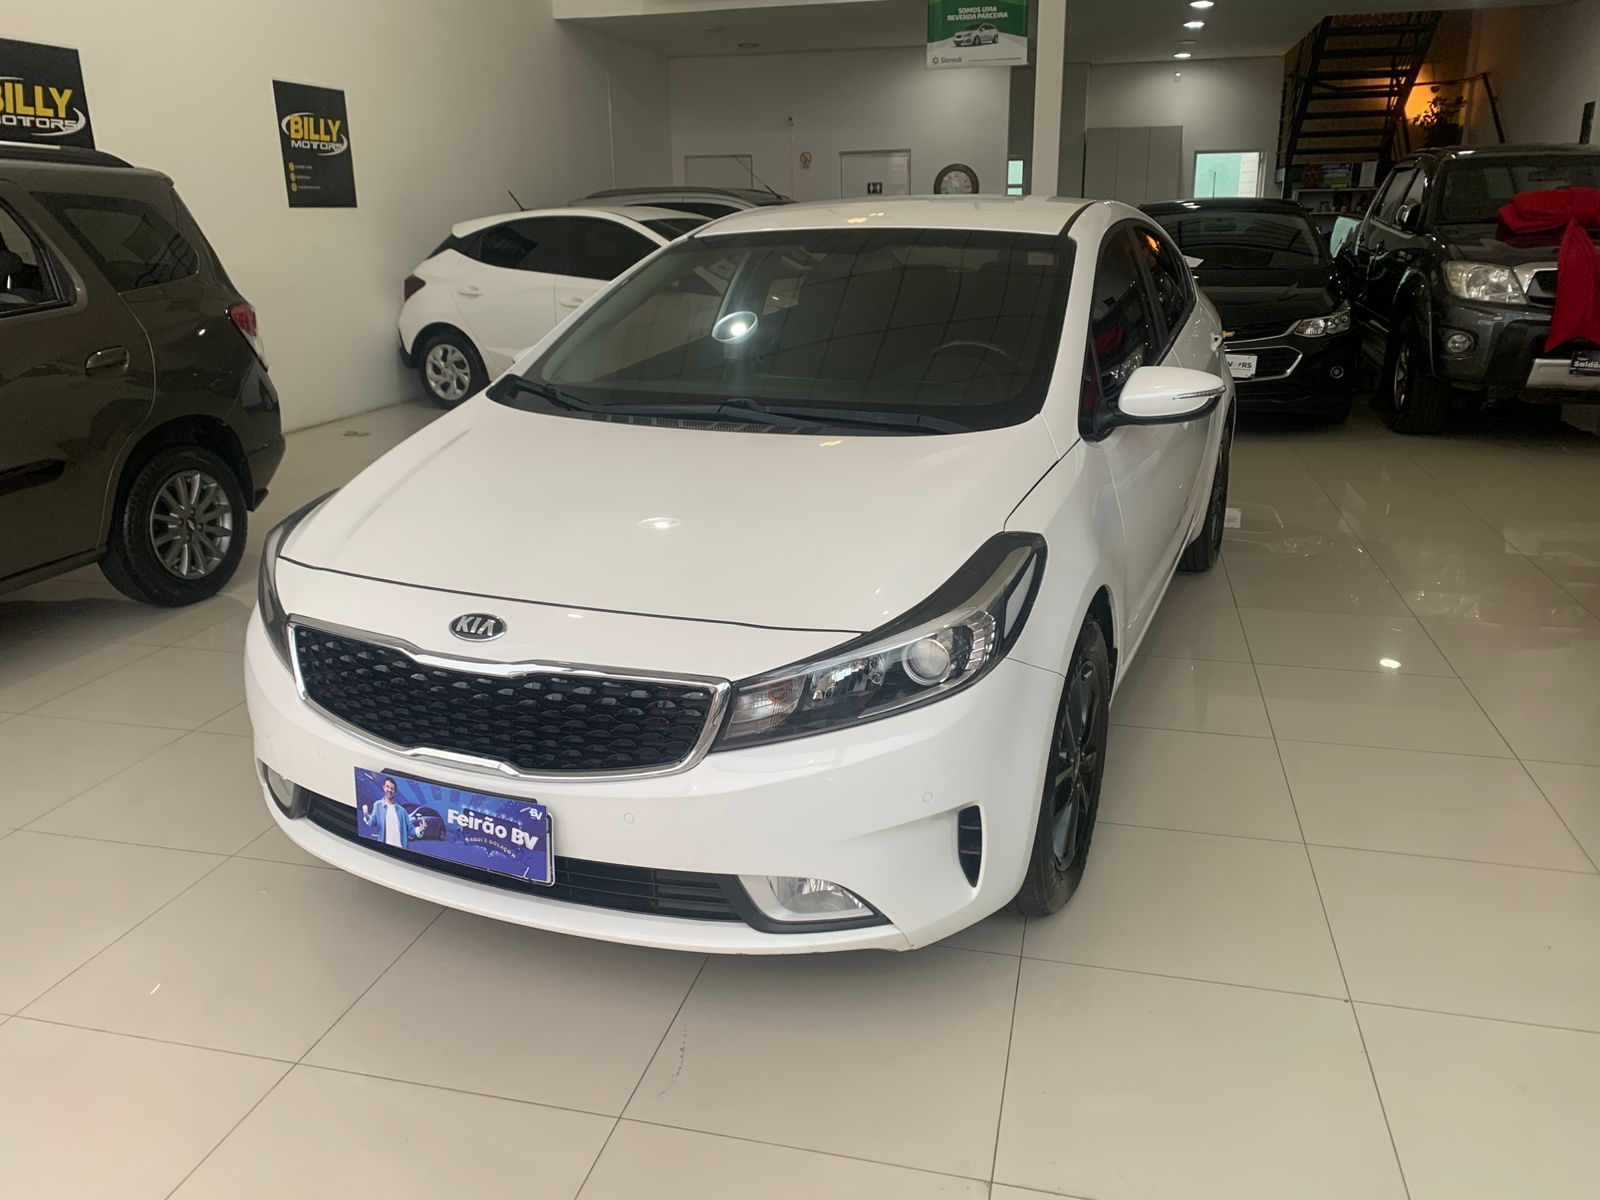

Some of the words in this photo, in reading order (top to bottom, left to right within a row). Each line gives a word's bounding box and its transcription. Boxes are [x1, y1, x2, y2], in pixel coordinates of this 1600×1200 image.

[947, 12, 977, 21] REVENDA
[977, 11, 1008, 19] PARCEIRA
[0, 82, 73, 118] ILLY
[0, 115, 77, 131] OTORS
[290, 115, 341, 142] BILLY
[291, 140, 343, 152] MOTORS
[455, 615, 496, 636] KIA
[529, 807, 543, 820] BV
[447, 808, 507, 838] Feirão
[511, 827, 539, 850] BV
